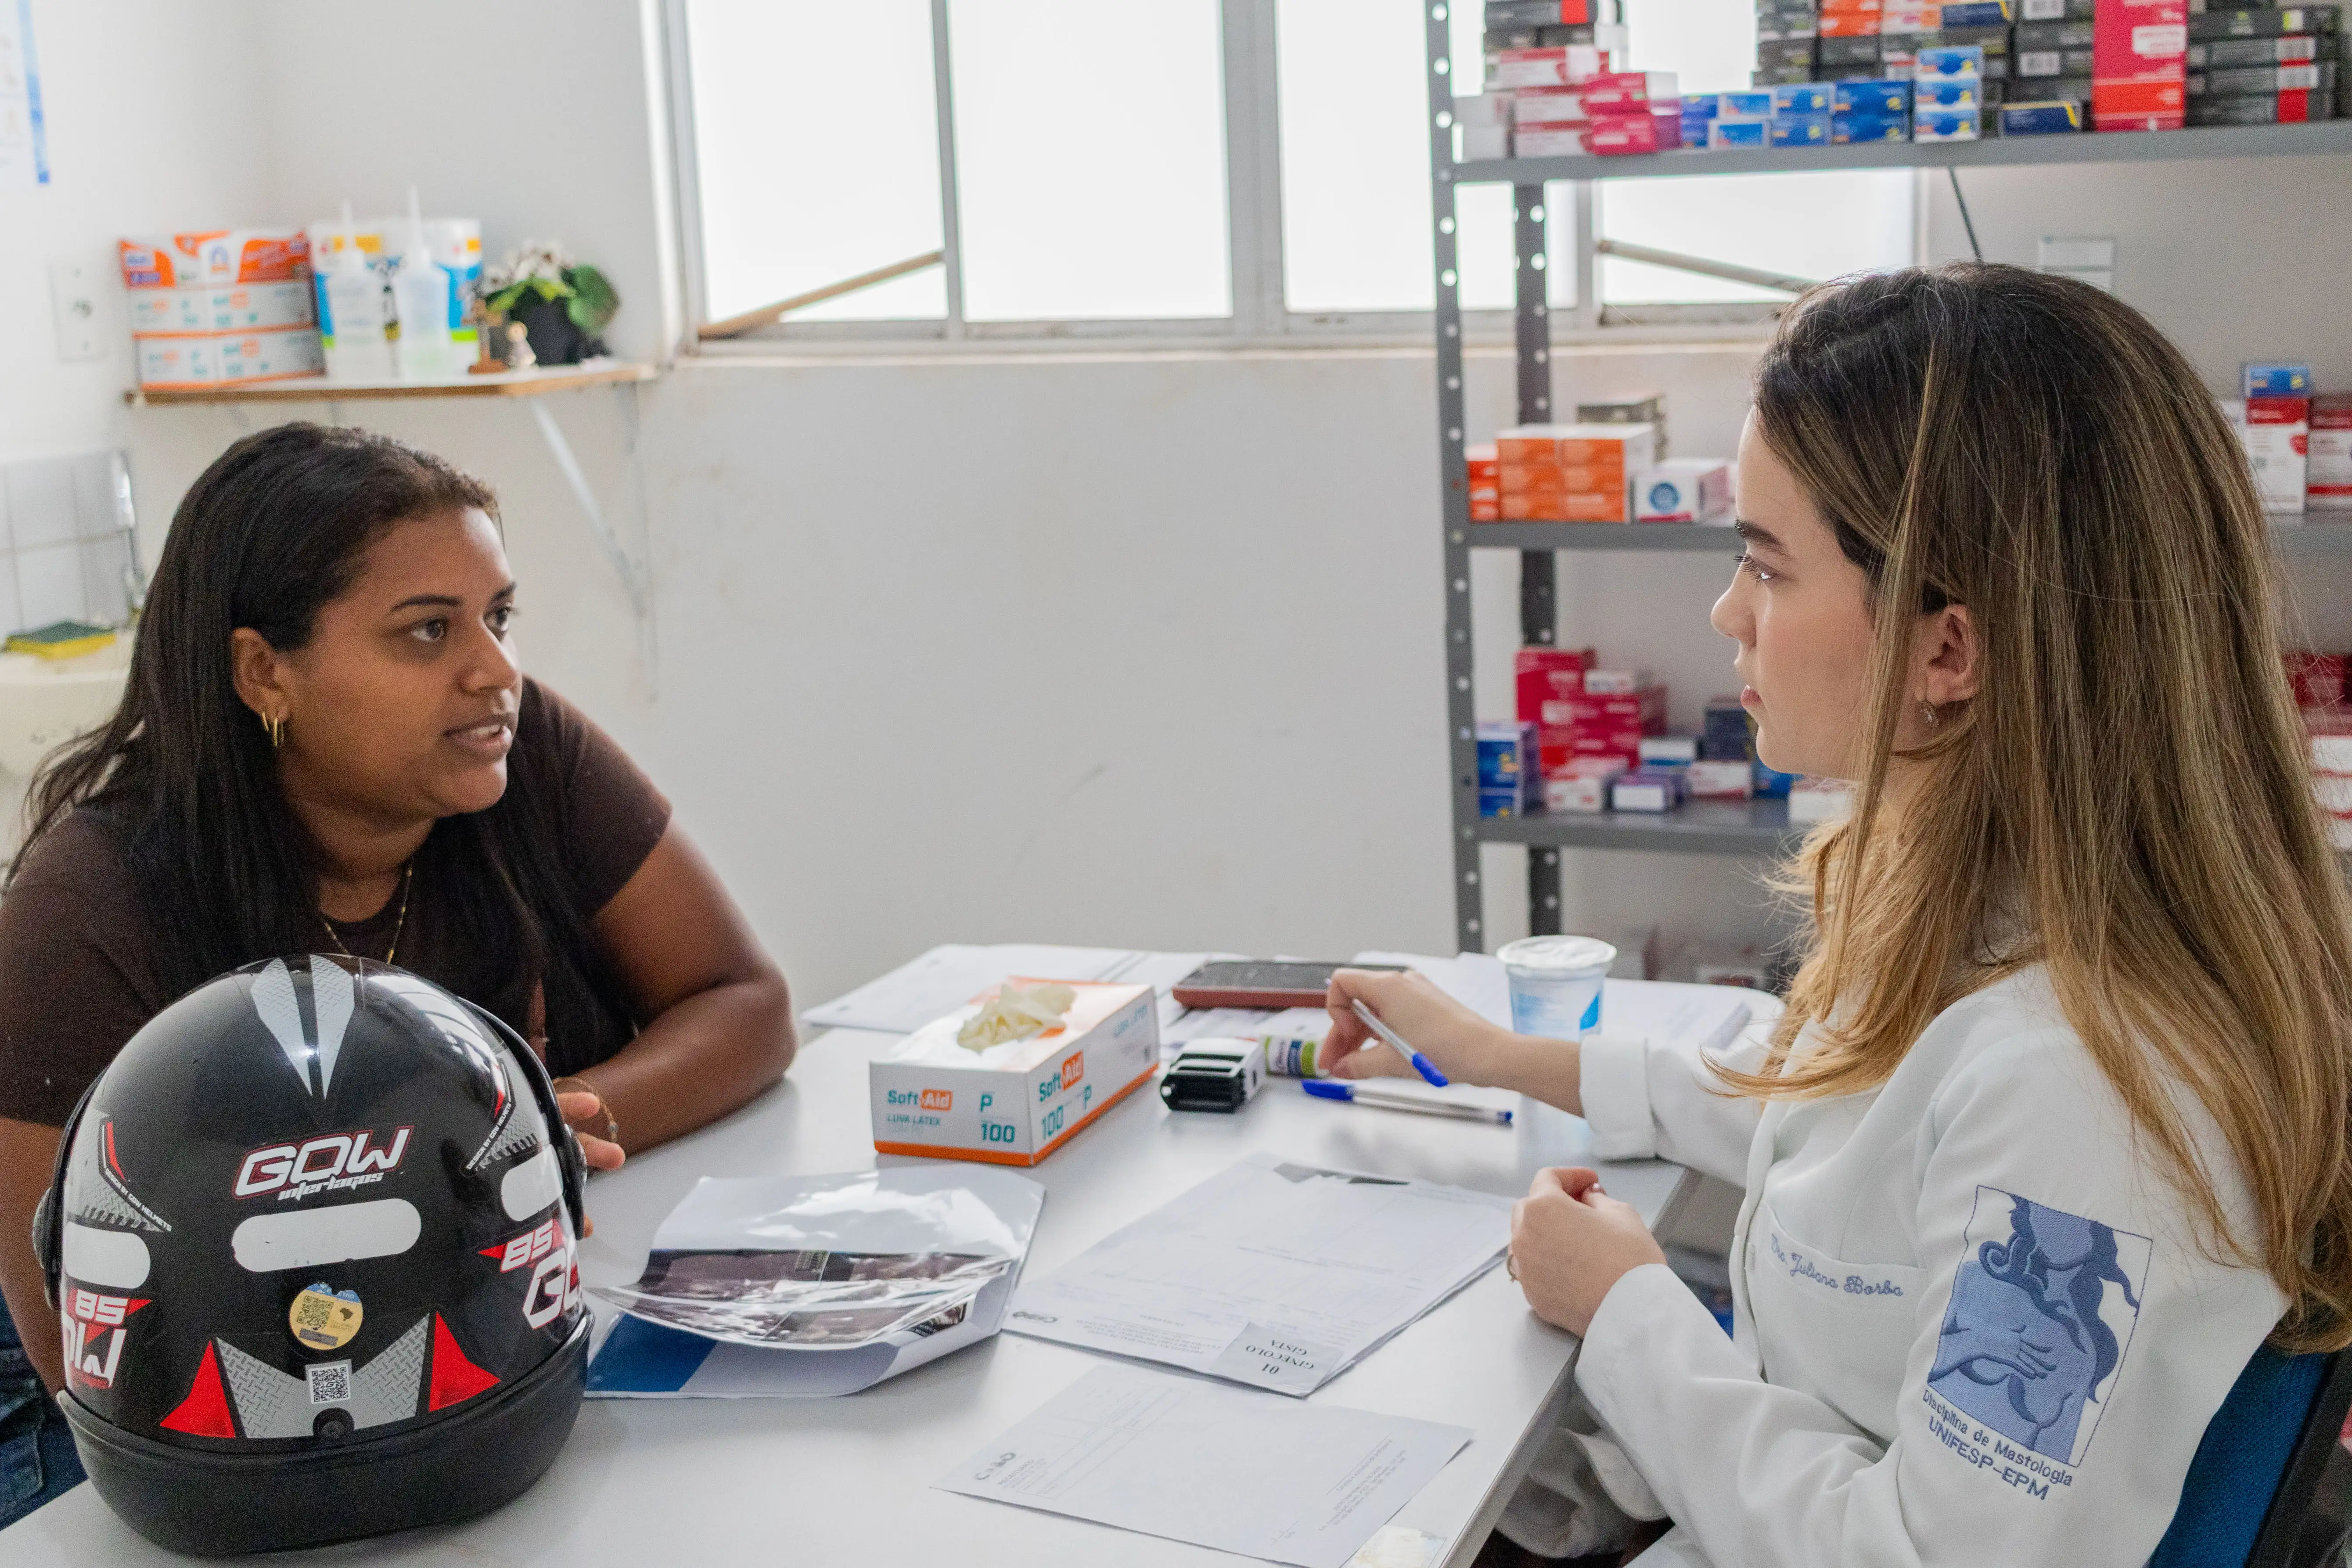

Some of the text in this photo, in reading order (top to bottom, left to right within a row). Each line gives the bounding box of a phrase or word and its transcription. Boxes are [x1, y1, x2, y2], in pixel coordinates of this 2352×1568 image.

[887, 1090, 919, 1105] Soft
[980, 1094, 993, 1112] P
[1082, 1085, 1092, 1110] P
[887, 1114, 940, 1126] LUVA LATEX
[1042, 1105, 1064, 1140] 100
[466, 1146, 486, 1170] DESIGN
[483, 1138, 491, 1147] BY
[497, 1102, 512, 1126] HELMETS
[981, 1122, 1015, 1143] 100
[233, 1127, 413, 1198] GOW
[121, 1185, 129, 1195] BY
[141, 1205, 173, 1232] HELMETS
[1790, 1252, 1839, 1289] Juliana
[1843, 1275, 1904, 1296] Borba
[1245, 1345, 1314, 1369] GINECOLO
[1272, 1339, 1307, 1356] GISTA
[1261, 1363, 1280, 1374] 01
[1922, 1389, 2073, 1486] Disciplina de Mastologia
